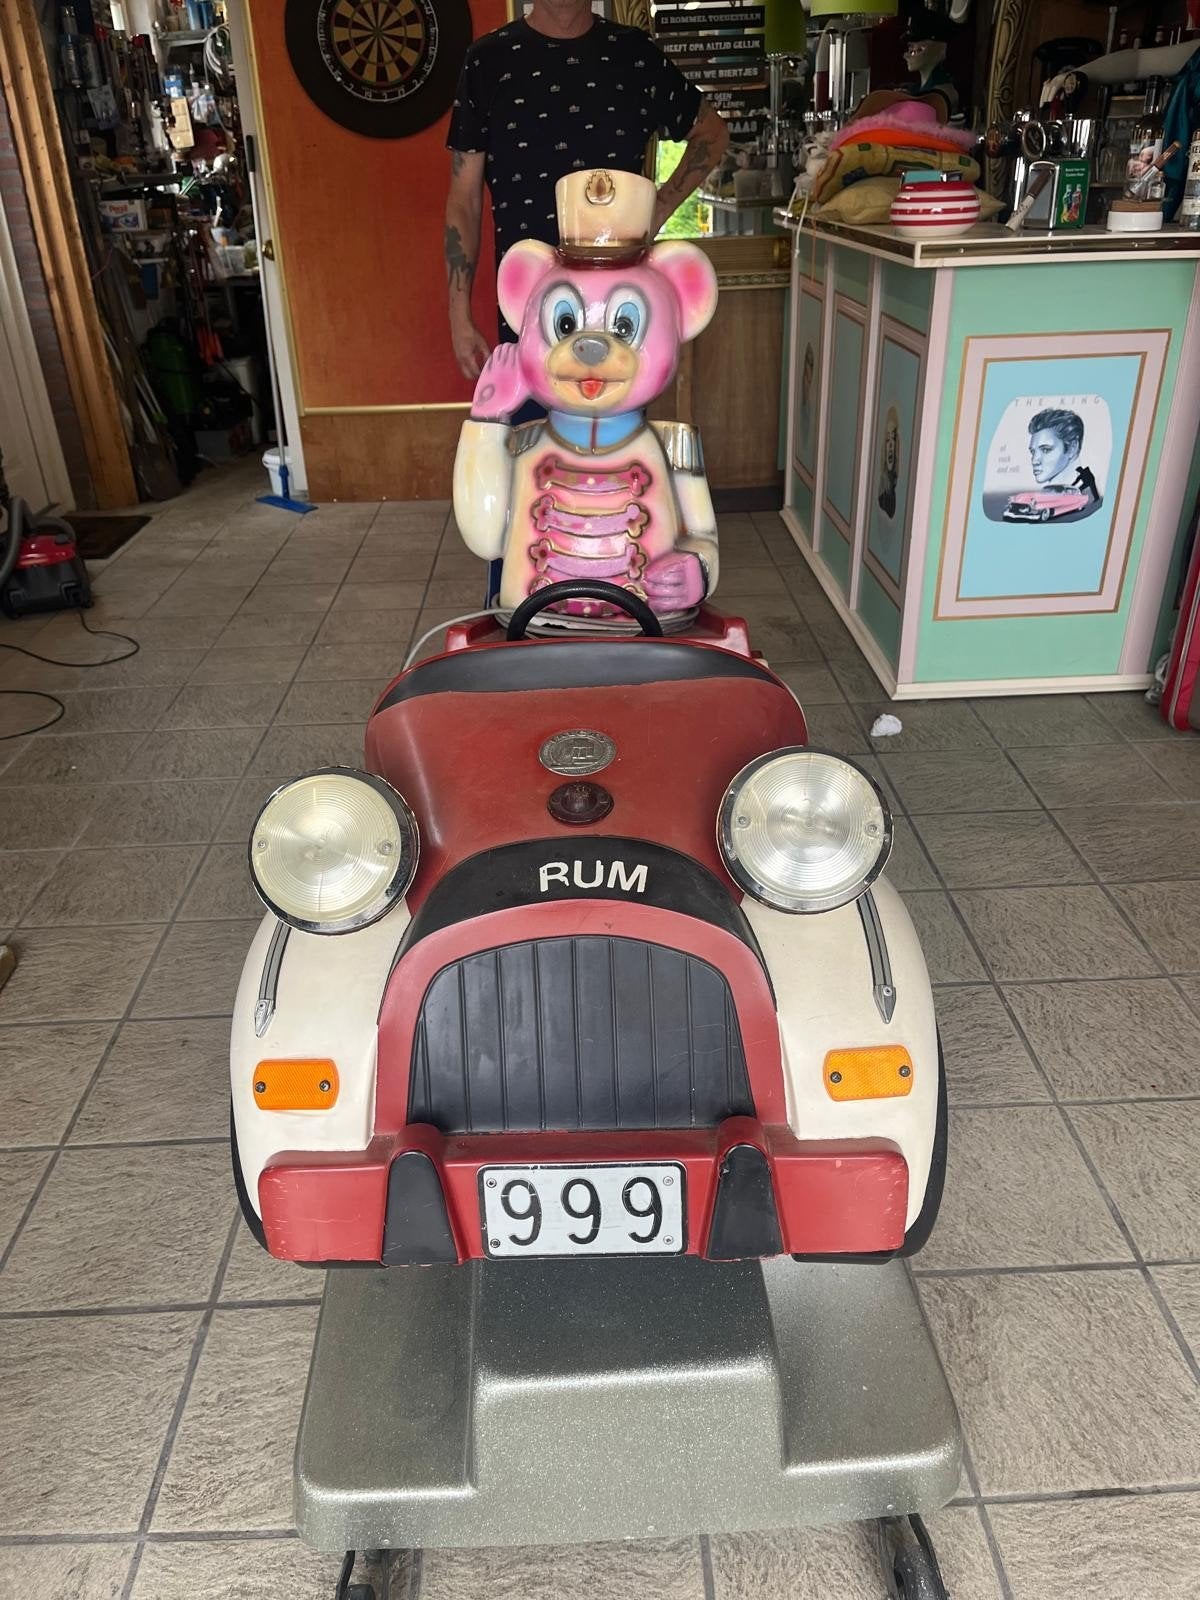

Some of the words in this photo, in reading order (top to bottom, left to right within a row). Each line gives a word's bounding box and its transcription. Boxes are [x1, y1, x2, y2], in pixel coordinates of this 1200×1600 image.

[669, 15, 707, 24] ROMMEL
[664, 44, 687, 53] HEEFT
[689, 42, 705, 52] OPA
[733, 40, 760, 49] GELIJK
[703, 69, 718, 79] WE
[719, 67, 758, 77] BIERTJES
[1015, 398, 1043, 407] THE
[1060, 396, 1101, 405] KING
[538, 860, 649, 893] RUM
